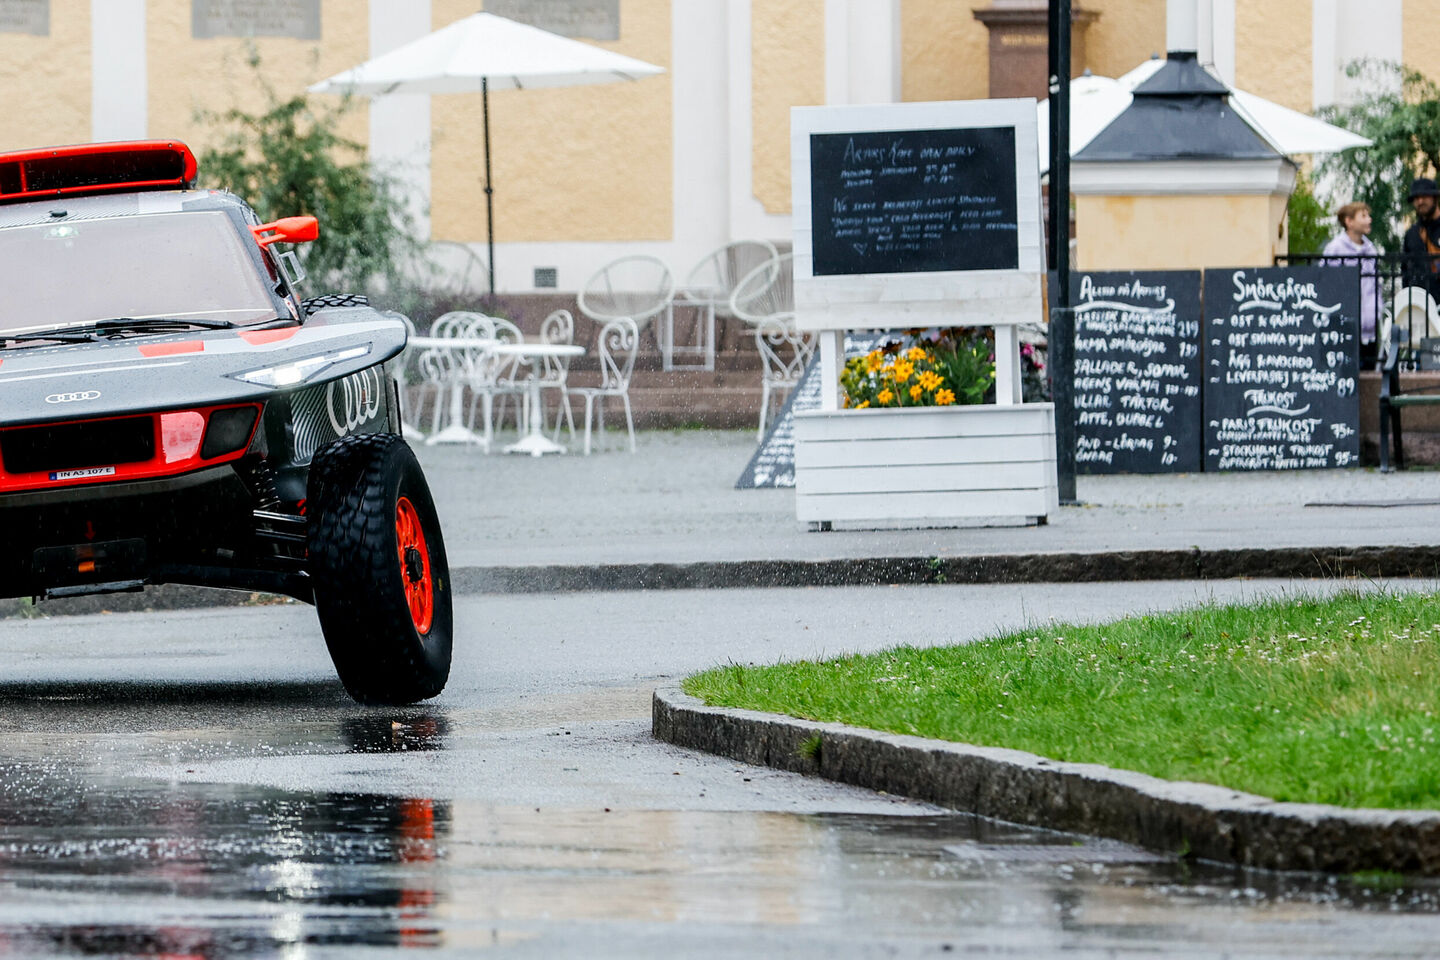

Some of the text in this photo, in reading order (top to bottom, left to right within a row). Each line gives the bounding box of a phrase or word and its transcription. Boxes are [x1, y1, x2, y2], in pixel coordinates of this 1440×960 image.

[1230, 314, 1255, 329] OST
[1228, 333, 1249, 348] OST
[1074, 377, 1112, 394] AGENS
[1074, 393, 1112, 409] ULLAR
[1074, 411, 1113, 428] ATTE,
[1075, 448, 1114, 465] ÖNDAG
